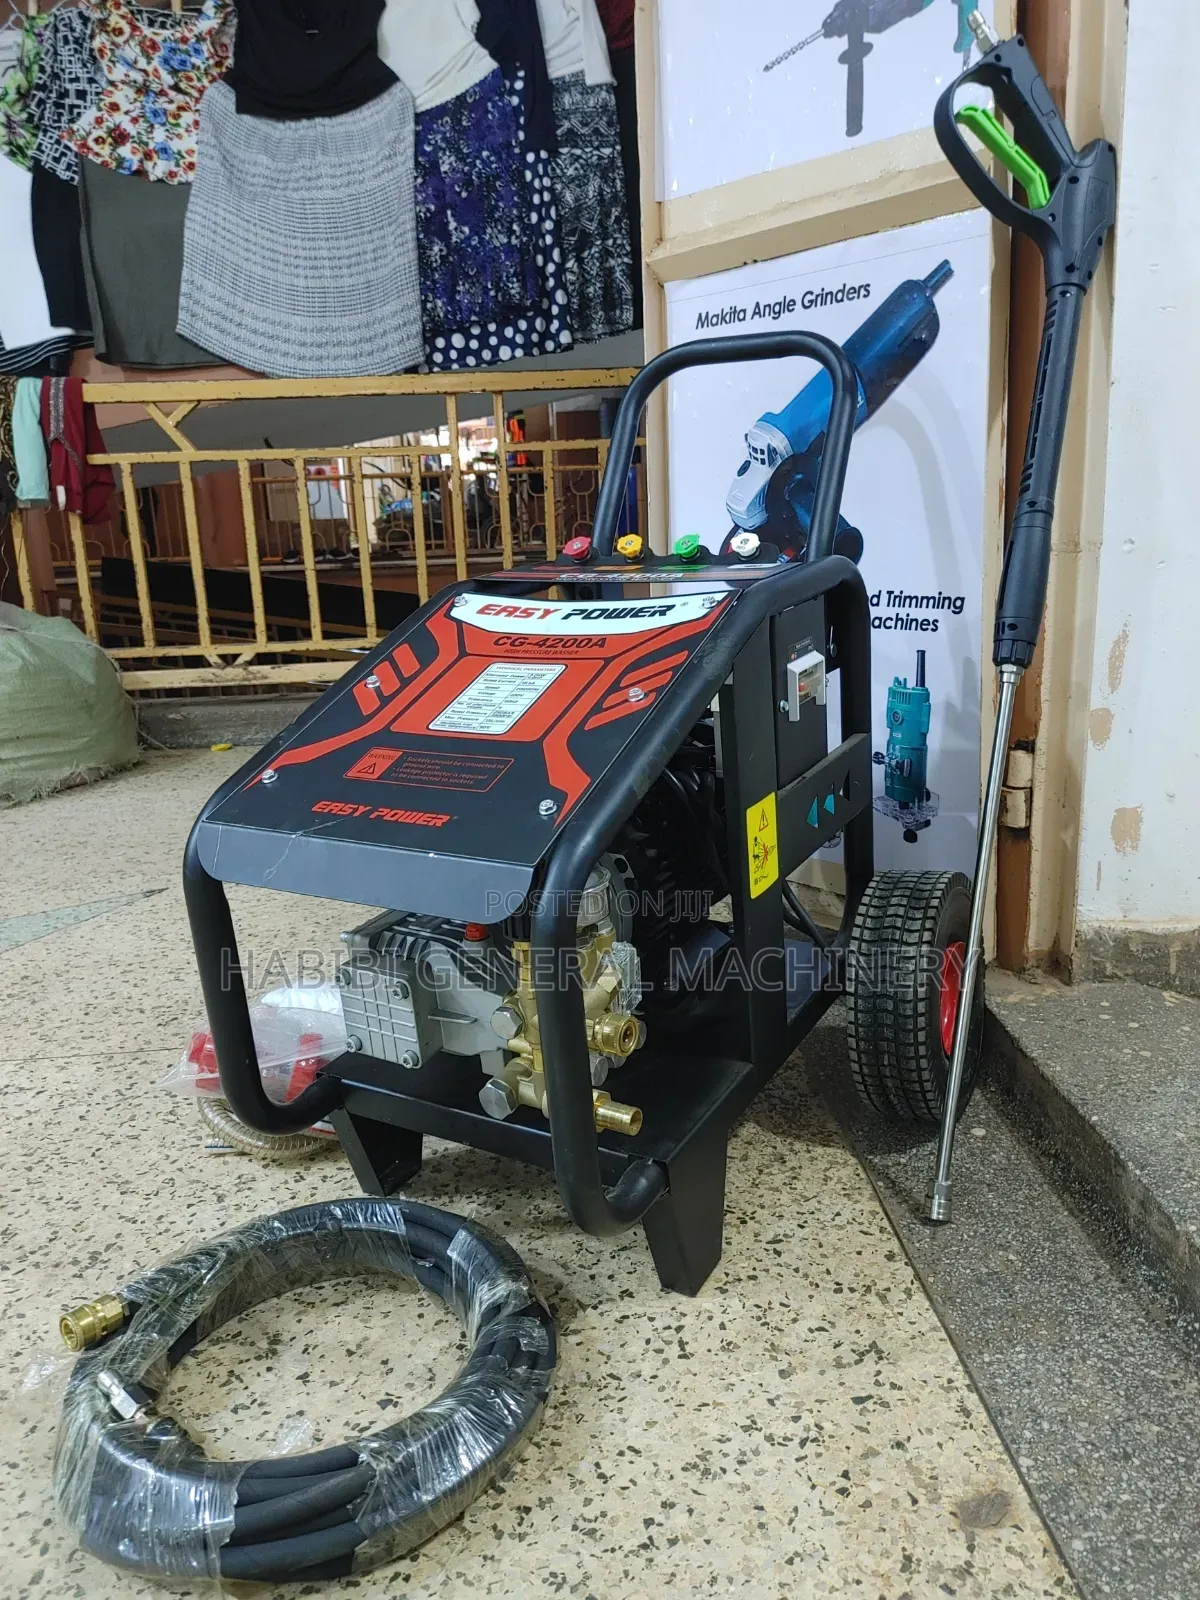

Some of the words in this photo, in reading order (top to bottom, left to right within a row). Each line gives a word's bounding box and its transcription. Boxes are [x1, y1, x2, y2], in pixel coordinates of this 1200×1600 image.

[695, 306, 748, 330] Makita
[751, 296, 797, 321] Angle
[801, 283, 871, 310] Grinders
[475, 603, 562, 619] EASY
[561, 603, 677, 620] POWER
[886, 590, 966, 615] Trimming
[871, 612, 940, 632] achines
[493, 635, 608, 649] CG-4200A
[368, 752, 396, 761] WARNING
[311, 800, 373, 817] EASY
[369, 807, 451, 827] POWER
